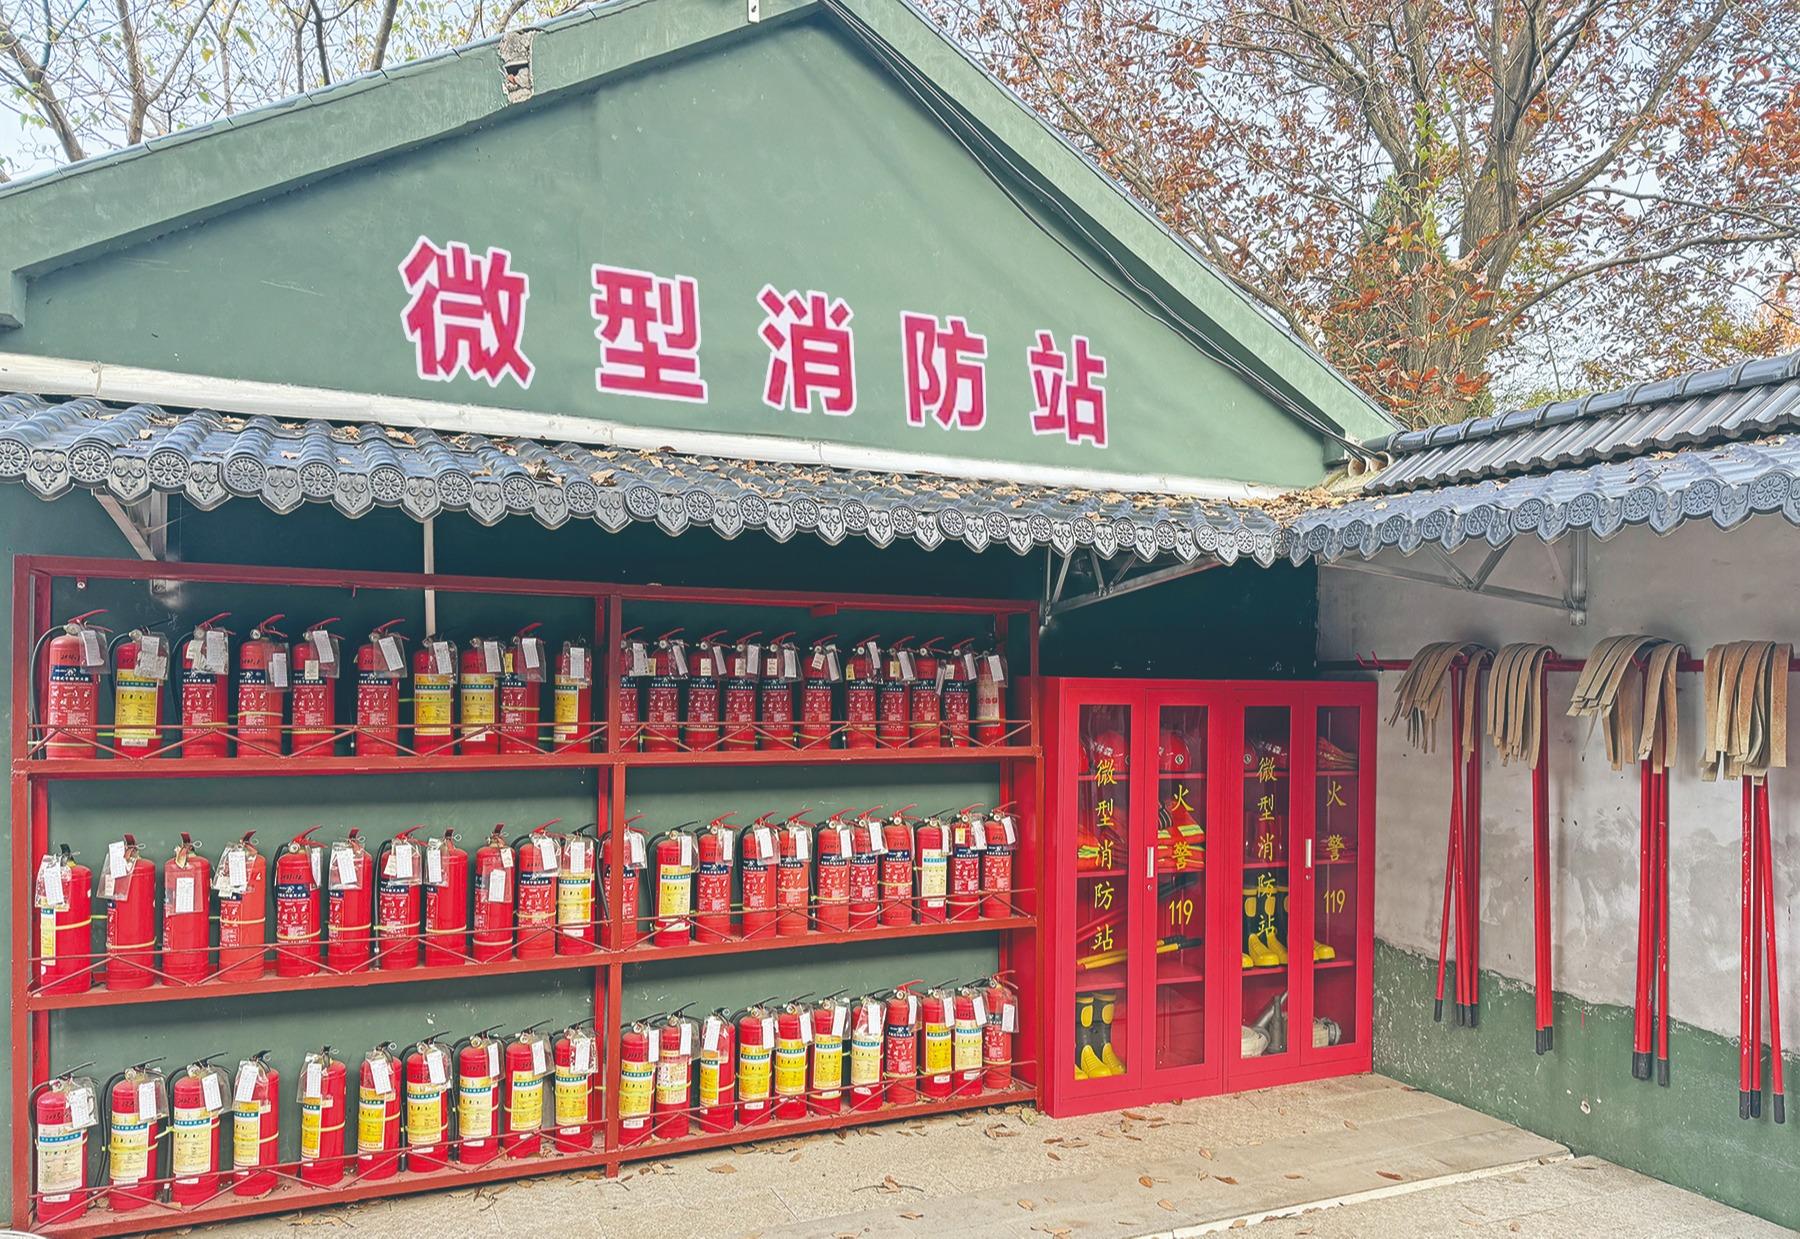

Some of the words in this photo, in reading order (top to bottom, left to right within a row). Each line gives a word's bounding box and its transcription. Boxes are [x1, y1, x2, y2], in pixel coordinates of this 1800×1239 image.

[399, 236, 1108, 448] 微型消防站
[1093, 759, 1116, 951] 微型消防站
[1257, 757, 1277, 937] 微型消防站
